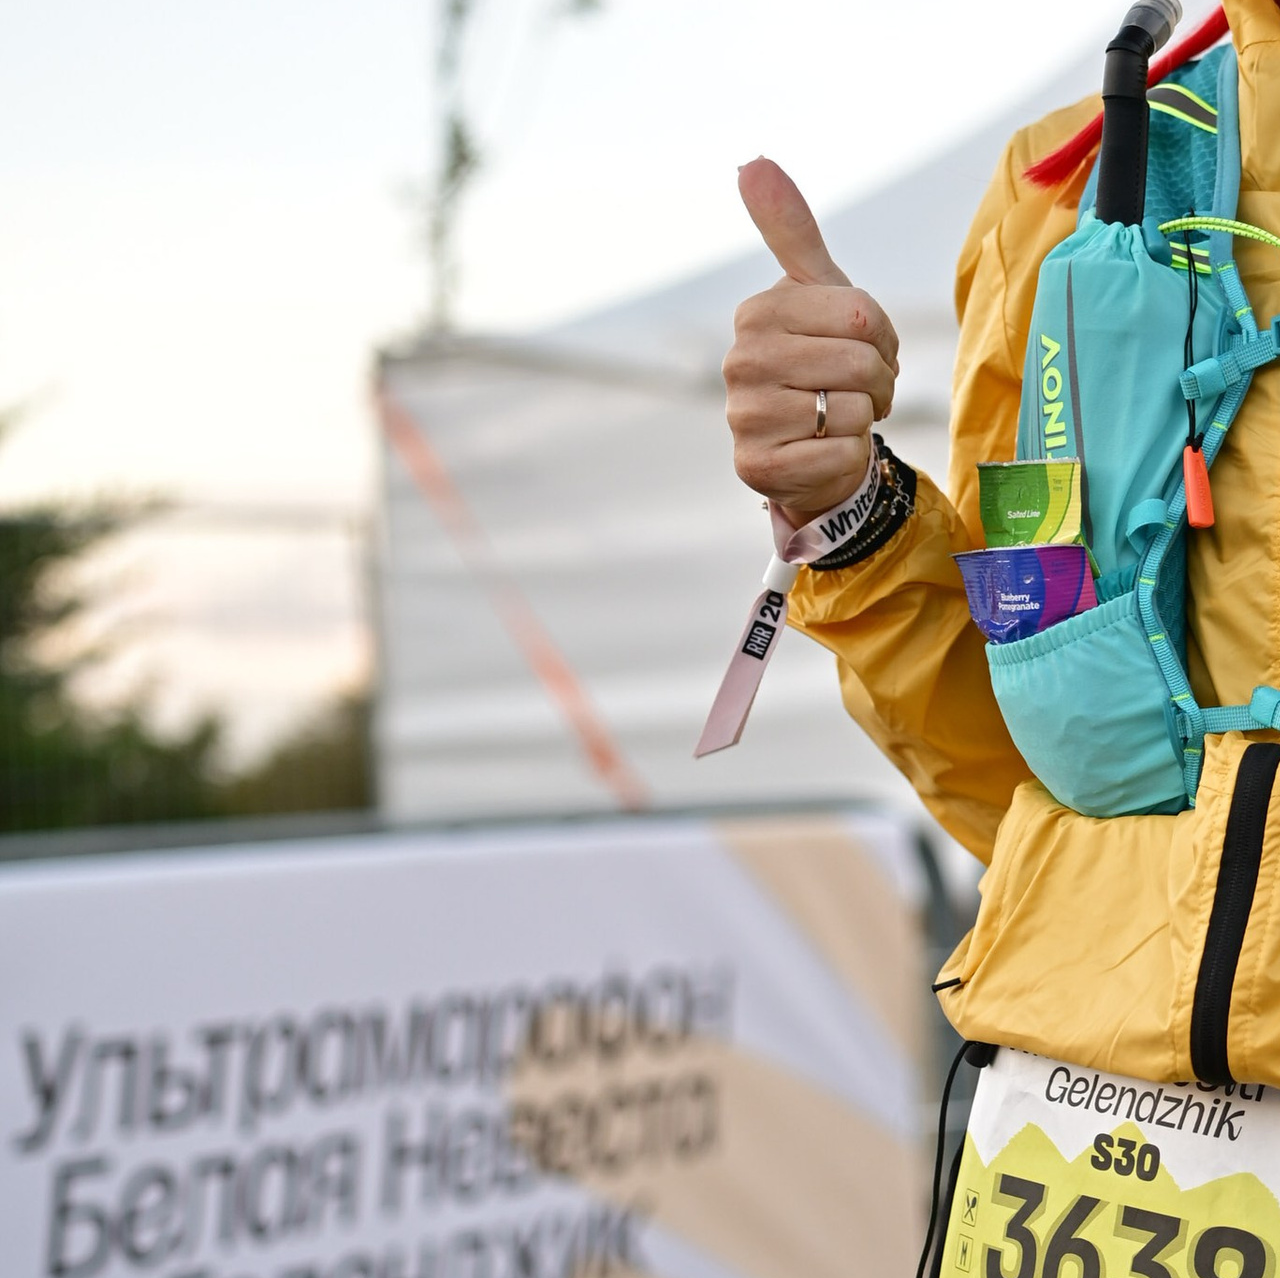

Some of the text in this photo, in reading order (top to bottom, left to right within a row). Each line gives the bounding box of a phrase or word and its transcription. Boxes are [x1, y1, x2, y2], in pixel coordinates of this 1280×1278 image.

[1040, 333, 1067, 459] AONI
[819, 465, 882, 543] WhiteB
[1007, 510, 1040, 519] Salted Lime
[745, 625, 775, 657] RHR
[1044, 1065, 1246, 1141] Gelendzhik
[1090, 1132, 1161, 1182] S30
